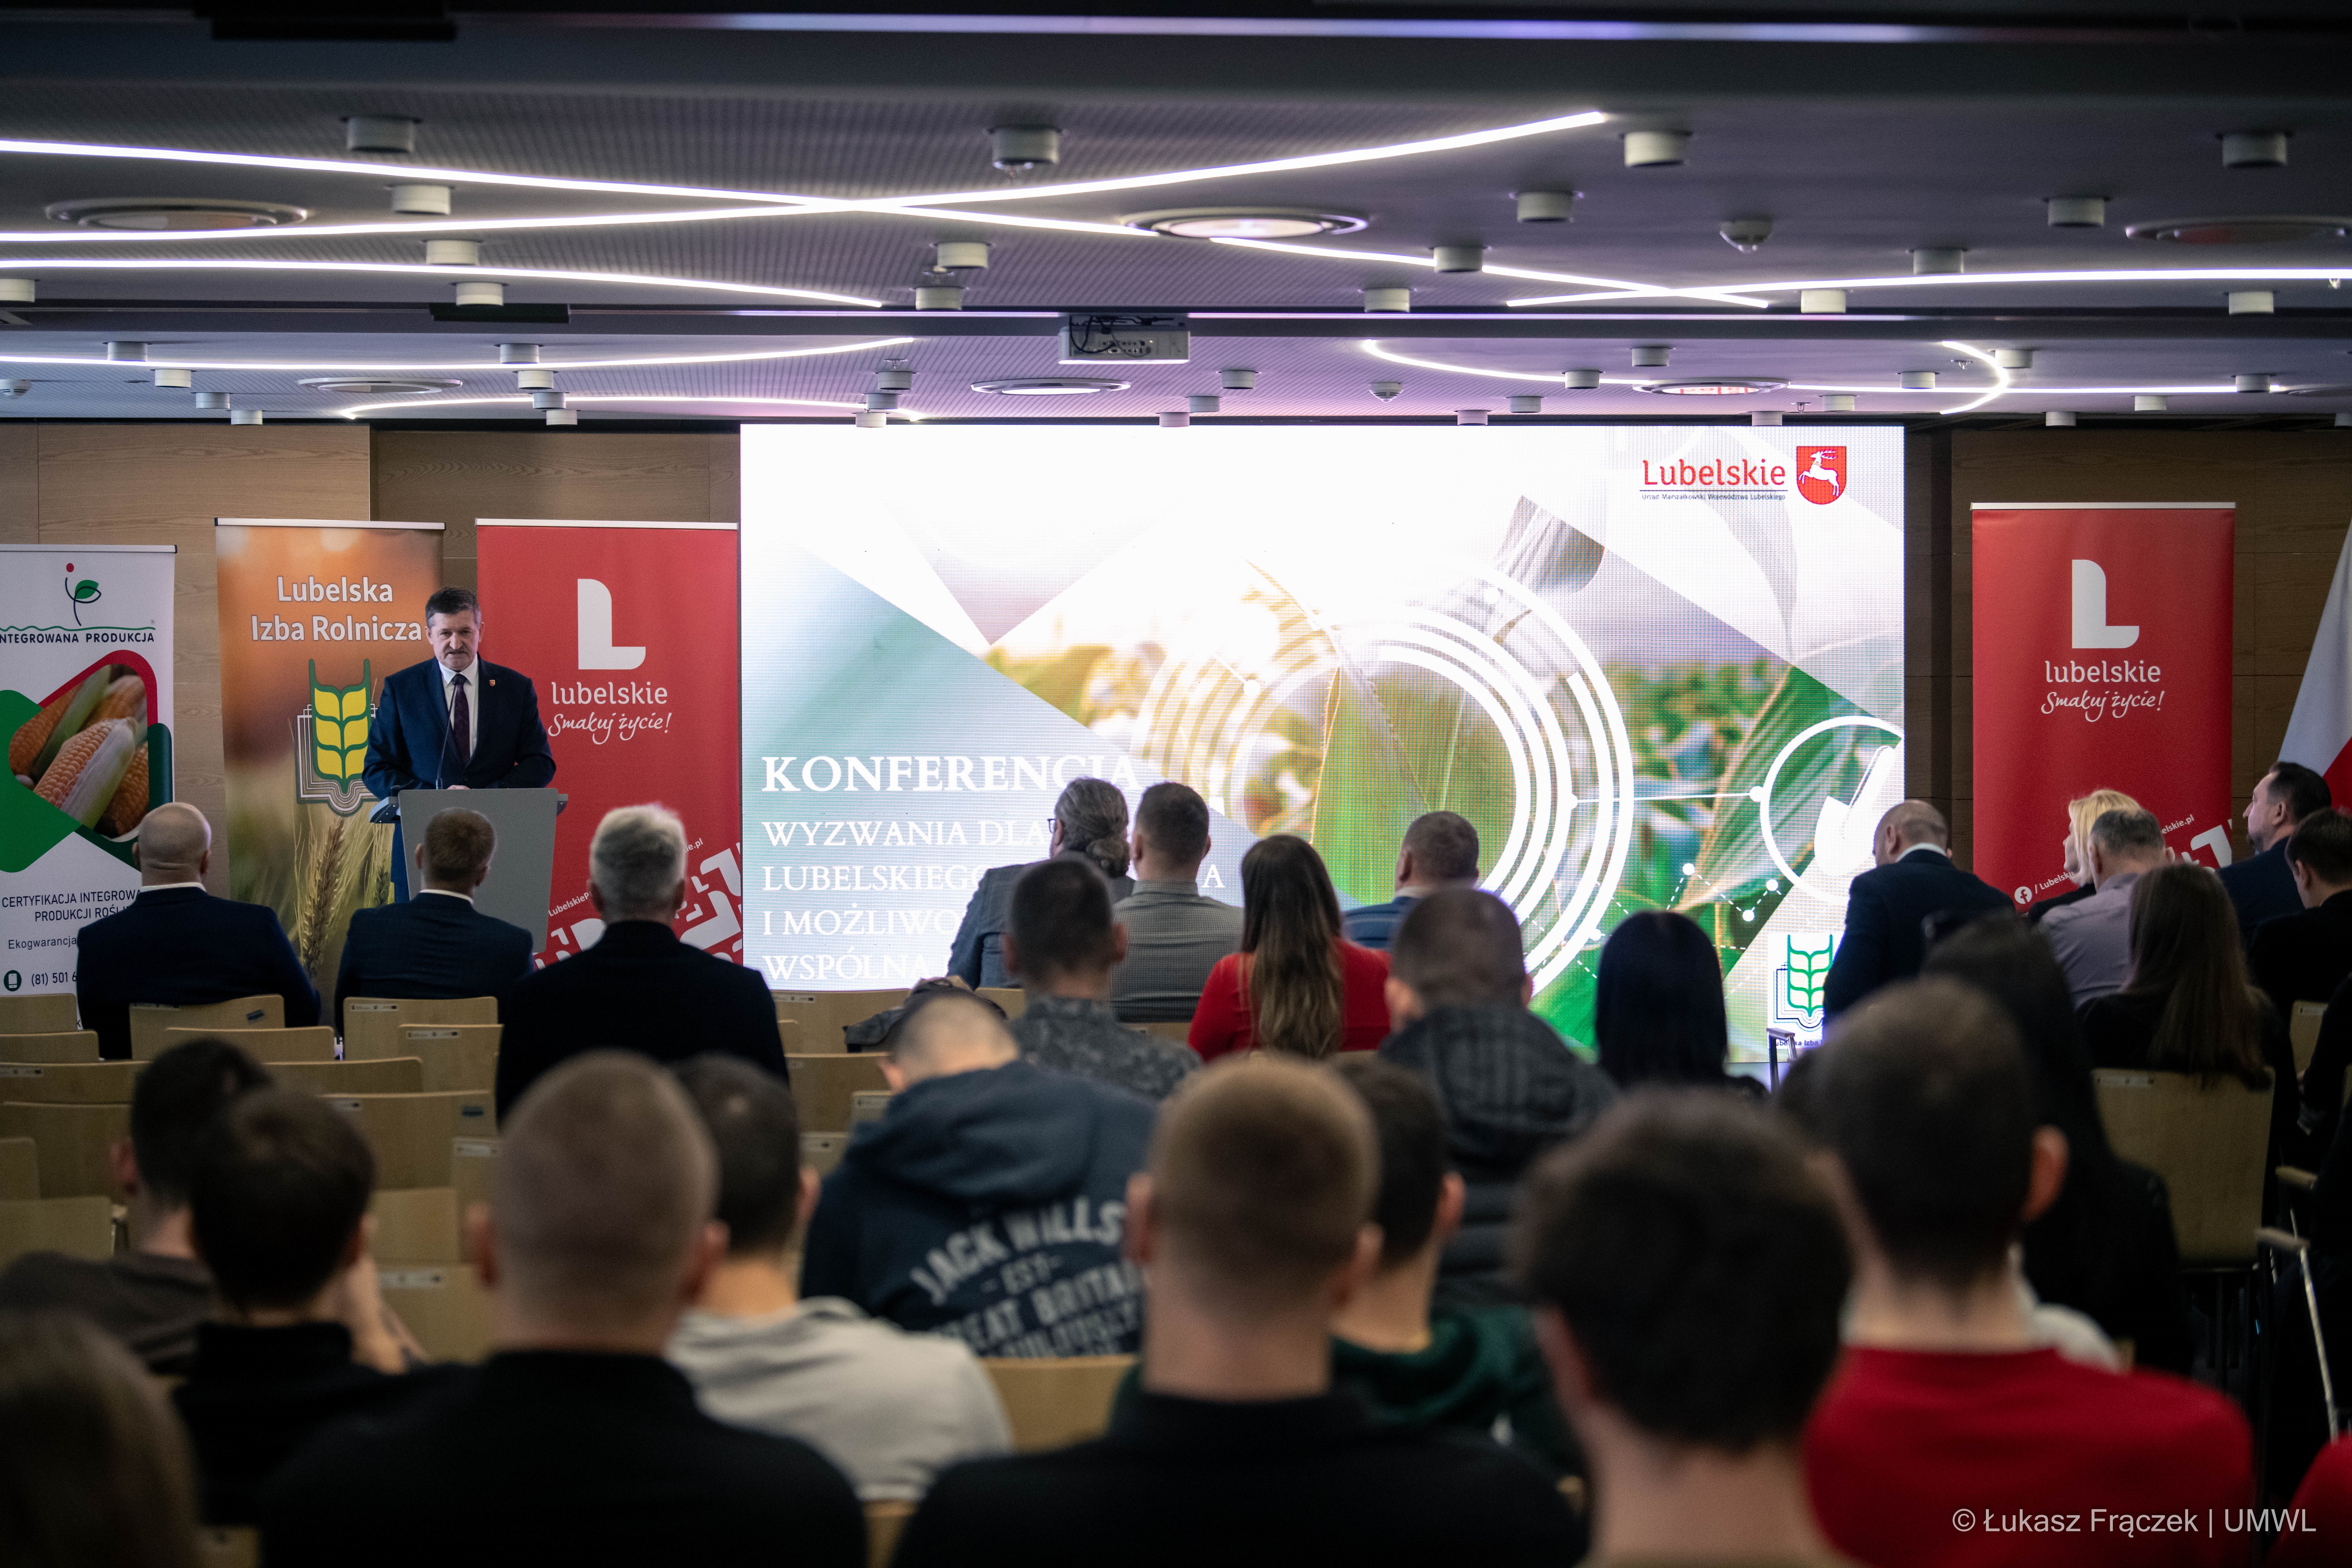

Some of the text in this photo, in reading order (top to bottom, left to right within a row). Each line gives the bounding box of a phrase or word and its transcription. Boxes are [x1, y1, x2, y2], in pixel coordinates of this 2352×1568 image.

[1643, 459, 1786, 486] Lubelskie
[277, 576, 393, 602] Lubelska
[86, 633, 154, 642] PRODUKCJA
[251, 615, 422, 641] Izba Rolnicza
[2045, 661, 2161, 682] lubelskie
[552, 681, 667, 704] lubelskie
[2041, 690, 2165, 722] Smakuj życie!
[548, 712, 672, 745] Smakuj życie!
[762, 820, 1045, 846] WYZWANIA DLA
[2161, 814, 2194, 834] elskie.pl
[2, 893, 77, 907] CERTYFIKACJA
[35, 908, 91, 922] PRODUKCJI
[763, 911, 772, 935] I
[9, 936, 76, 950] Ekogwarancja
[762, 946, 930, 980] WSPÓLNA
[31, 973, 48, 987] (81)
[53, 972, 68, 983] 501
